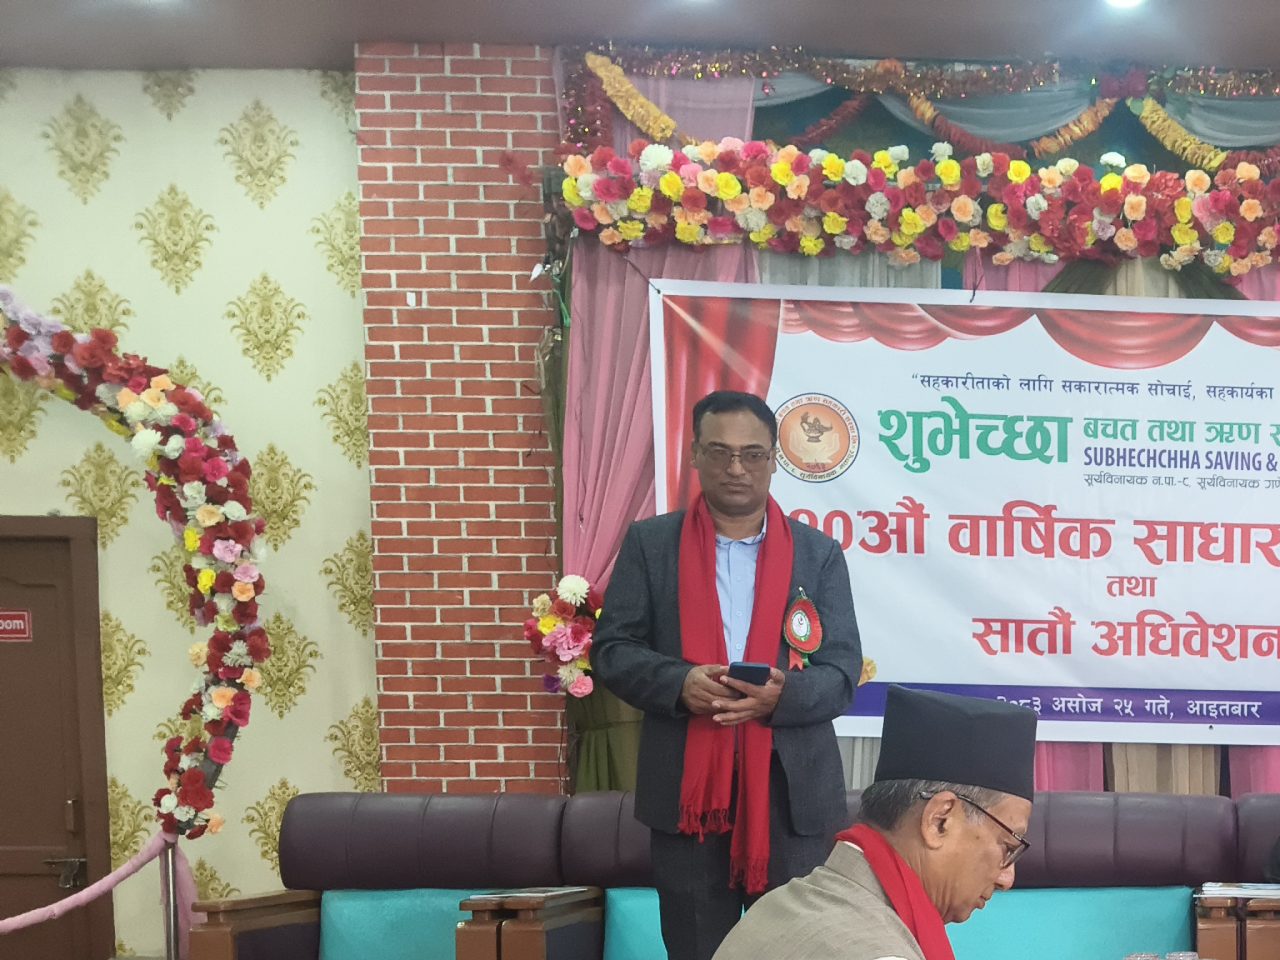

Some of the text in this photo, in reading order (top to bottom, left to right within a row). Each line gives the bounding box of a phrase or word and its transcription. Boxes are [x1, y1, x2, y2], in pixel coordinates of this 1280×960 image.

[1019, 374, 1053, 392] लागि
[1062, 380, 1139, 395] सकारात्मक
[878, 396, 1073, 474] शुभेच्छा
[1083, 417, 1139, 441] बचत
[1147, 419, 1196, 442] तथा
[1204, 421, 1262, 444] ऋण
[1084, 446, 1200, 469] SUBHECHCHHA
[1205, 450, 1262, 471] SAVING
[1266, 453, 1278, 471] &
[948, 500, 1116, 559] वार्षिक
[1106, 575, 1158, 598] तथा
[0, 619, 24, 629] oom
[1052, 693, 1104, 713] असोज
[1113, 697, 1134, 717] २५
[1145, 696, 1174, 719] गते,
[1187, 699, 1262, 719] आइतबार
